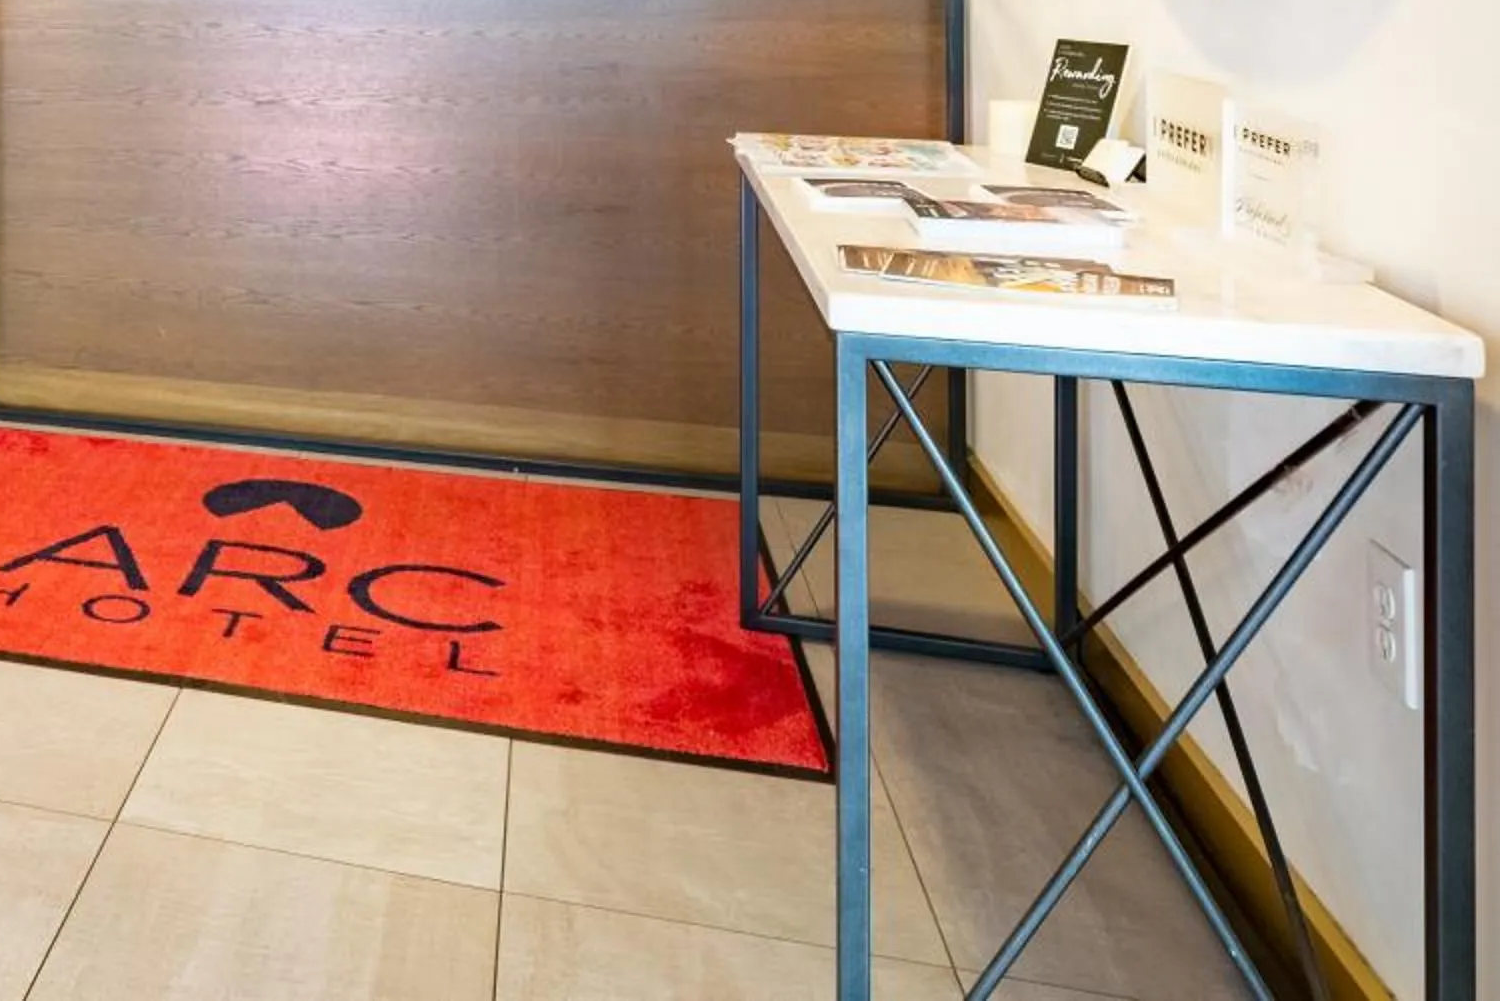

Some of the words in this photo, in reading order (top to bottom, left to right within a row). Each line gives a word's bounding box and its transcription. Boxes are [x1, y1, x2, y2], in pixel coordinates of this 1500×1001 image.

[1049, 56, 1116, 100] Rewarding
[1160, 117, 1208, 157] PREFER
[1242, 126, 1291, 157] PREFER
